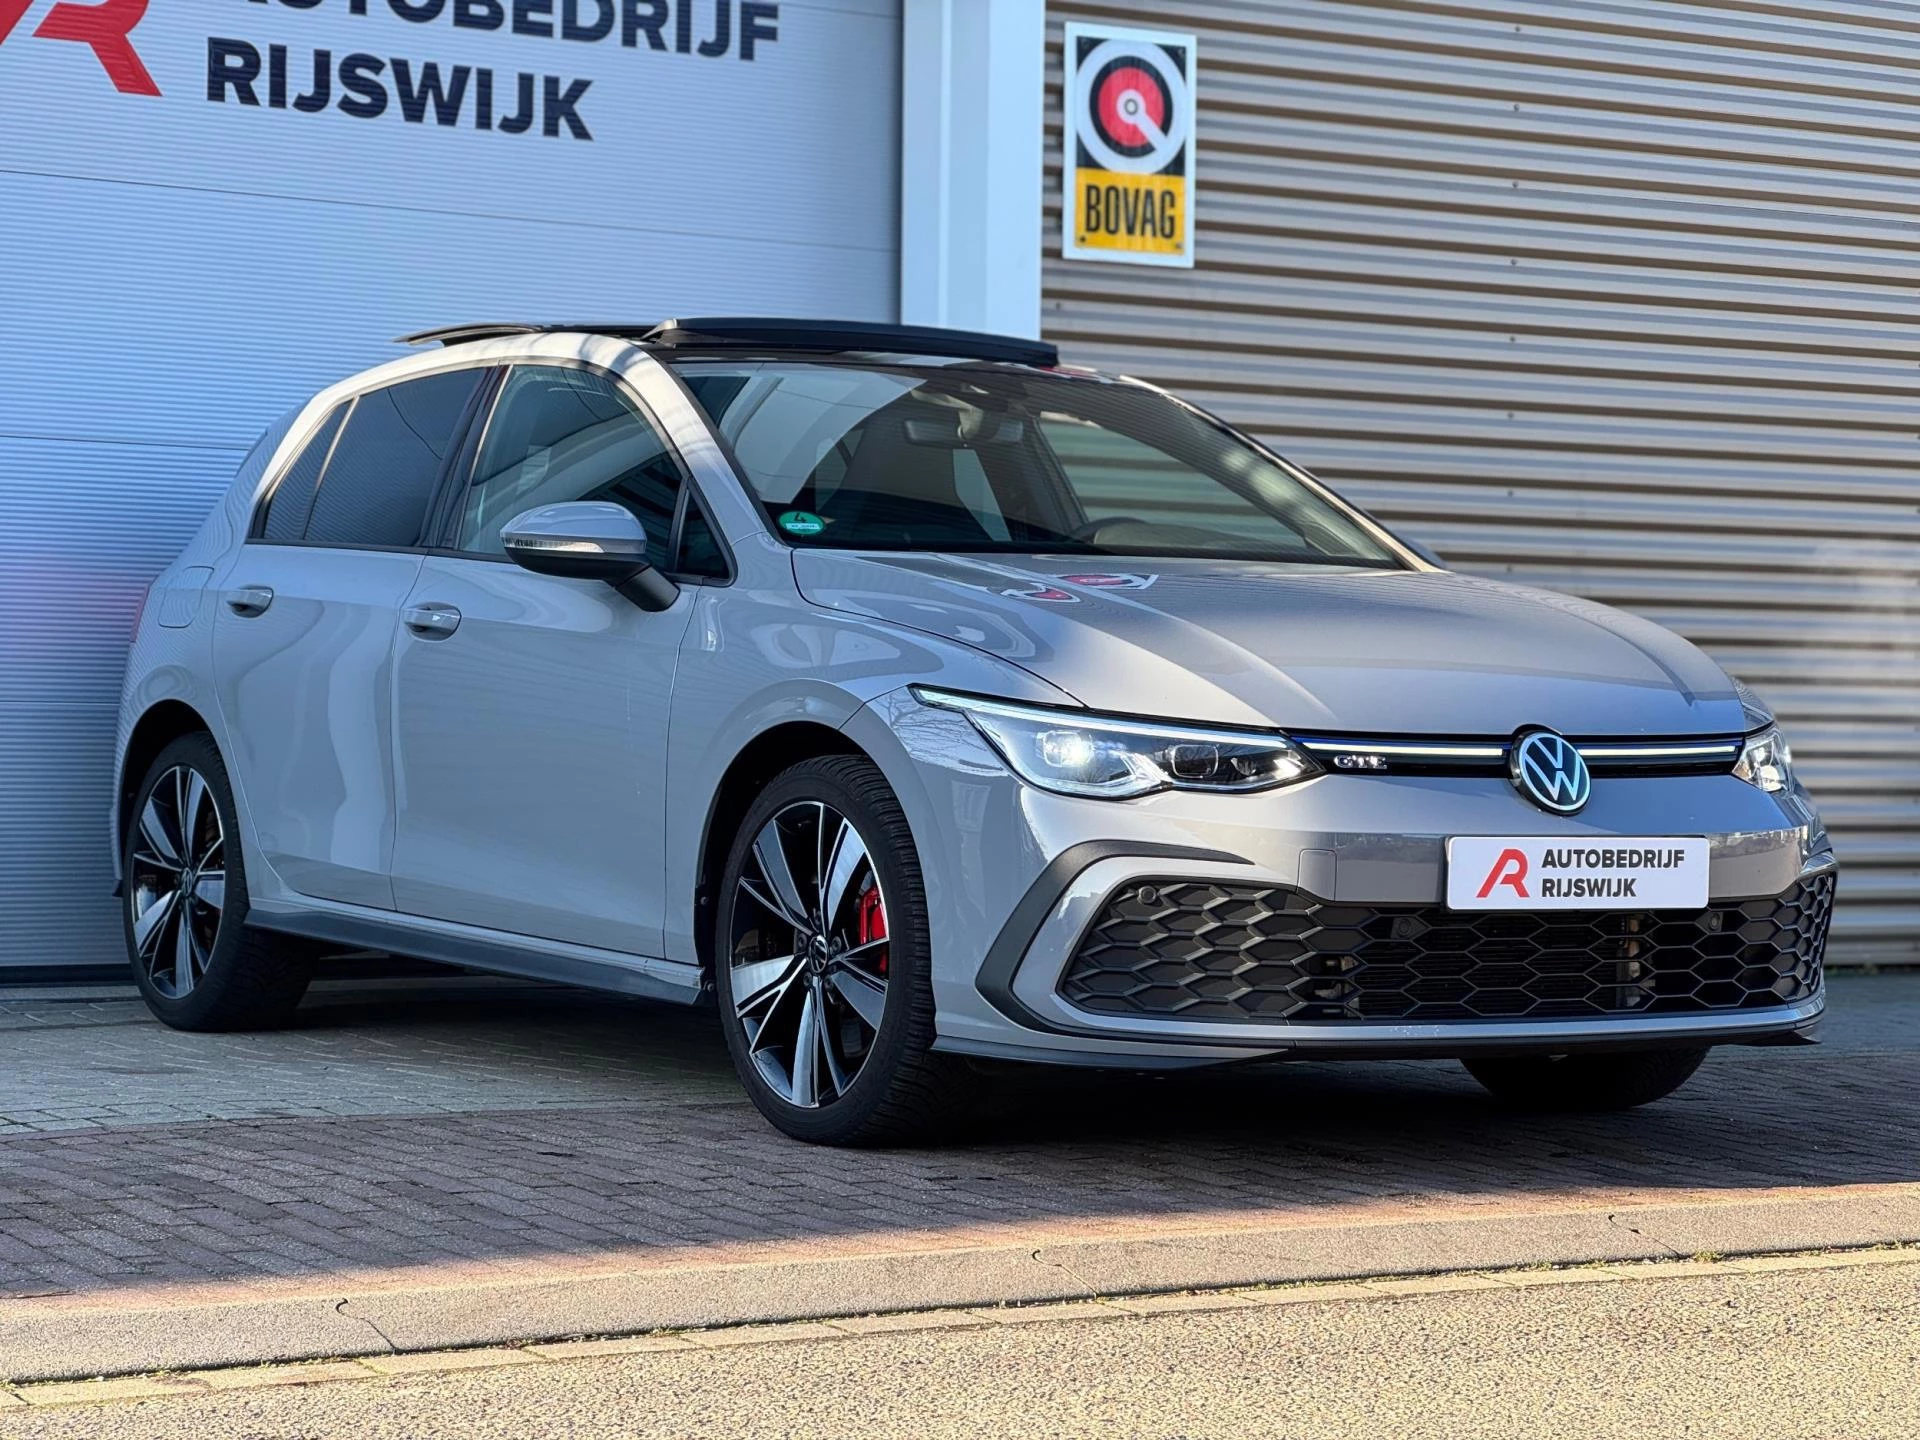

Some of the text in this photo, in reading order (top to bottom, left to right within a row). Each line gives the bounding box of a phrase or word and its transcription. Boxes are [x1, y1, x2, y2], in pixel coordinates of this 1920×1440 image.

[247, 0, 779, 62] EDRIJF
[206, 36, 593, 141] RIJSWIJK
[1085, 184, 1175, 240] BOVAG
[794, 512, 807, 524] 4
[1541, 848, 1685, 869] AUTOBEDRIJF
[1541, 878, 1637, 898] RIJSWIJK
